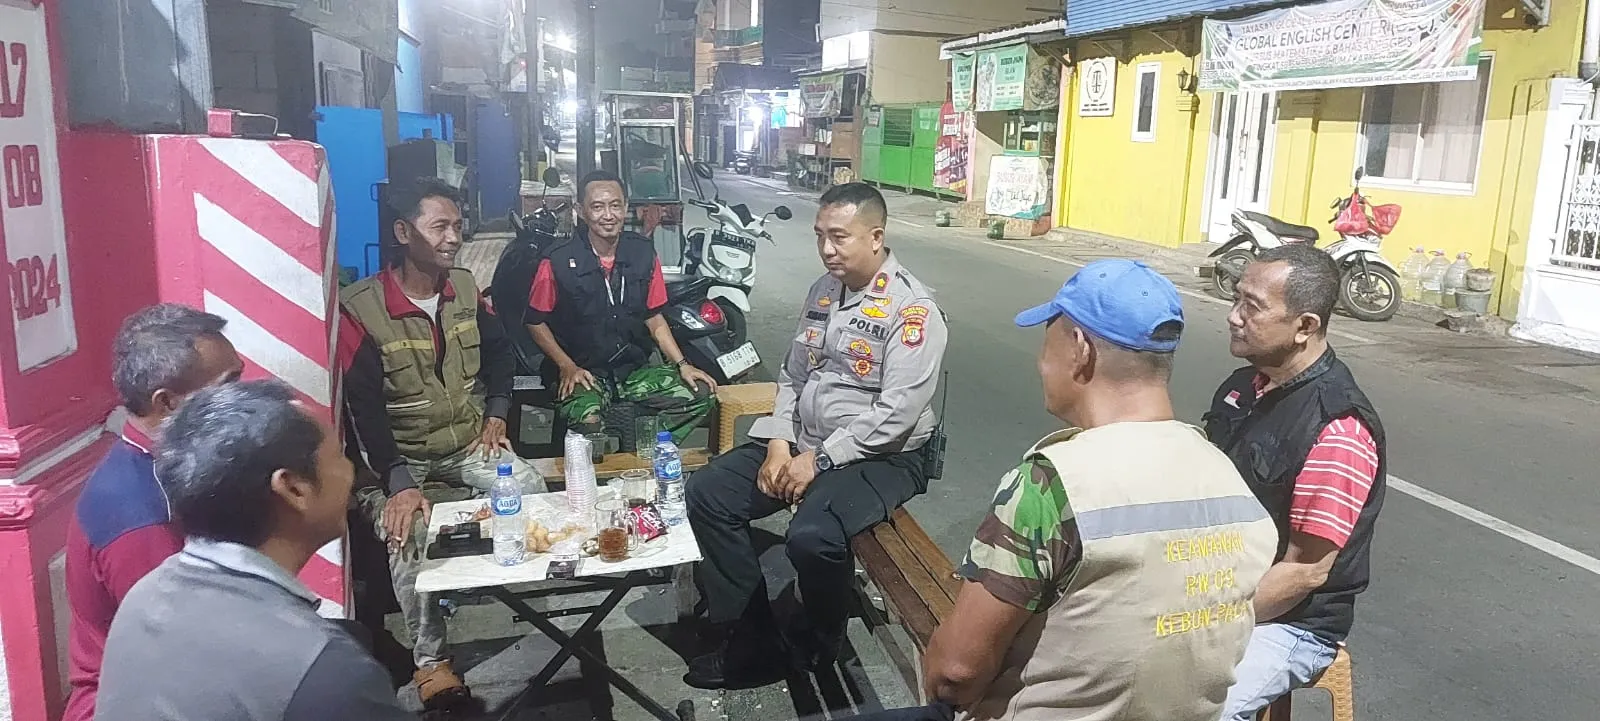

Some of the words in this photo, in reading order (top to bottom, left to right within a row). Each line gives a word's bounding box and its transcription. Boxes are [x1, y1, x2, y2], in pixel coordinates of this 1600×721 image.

[1235, 34, 1277, 51] GLOBAL
[1280, 25, 1331, 47] ENGLISH
[1333, 18, 1388, 41] CENTER
[4, 145, 42, 209] 08
[848, 317, 885, 340] POLRI
[498, 499, 518, 508] AQUA
[1214, 567, 1233, 590] 09
[1156, 606, 1211, 638] KEBUN
